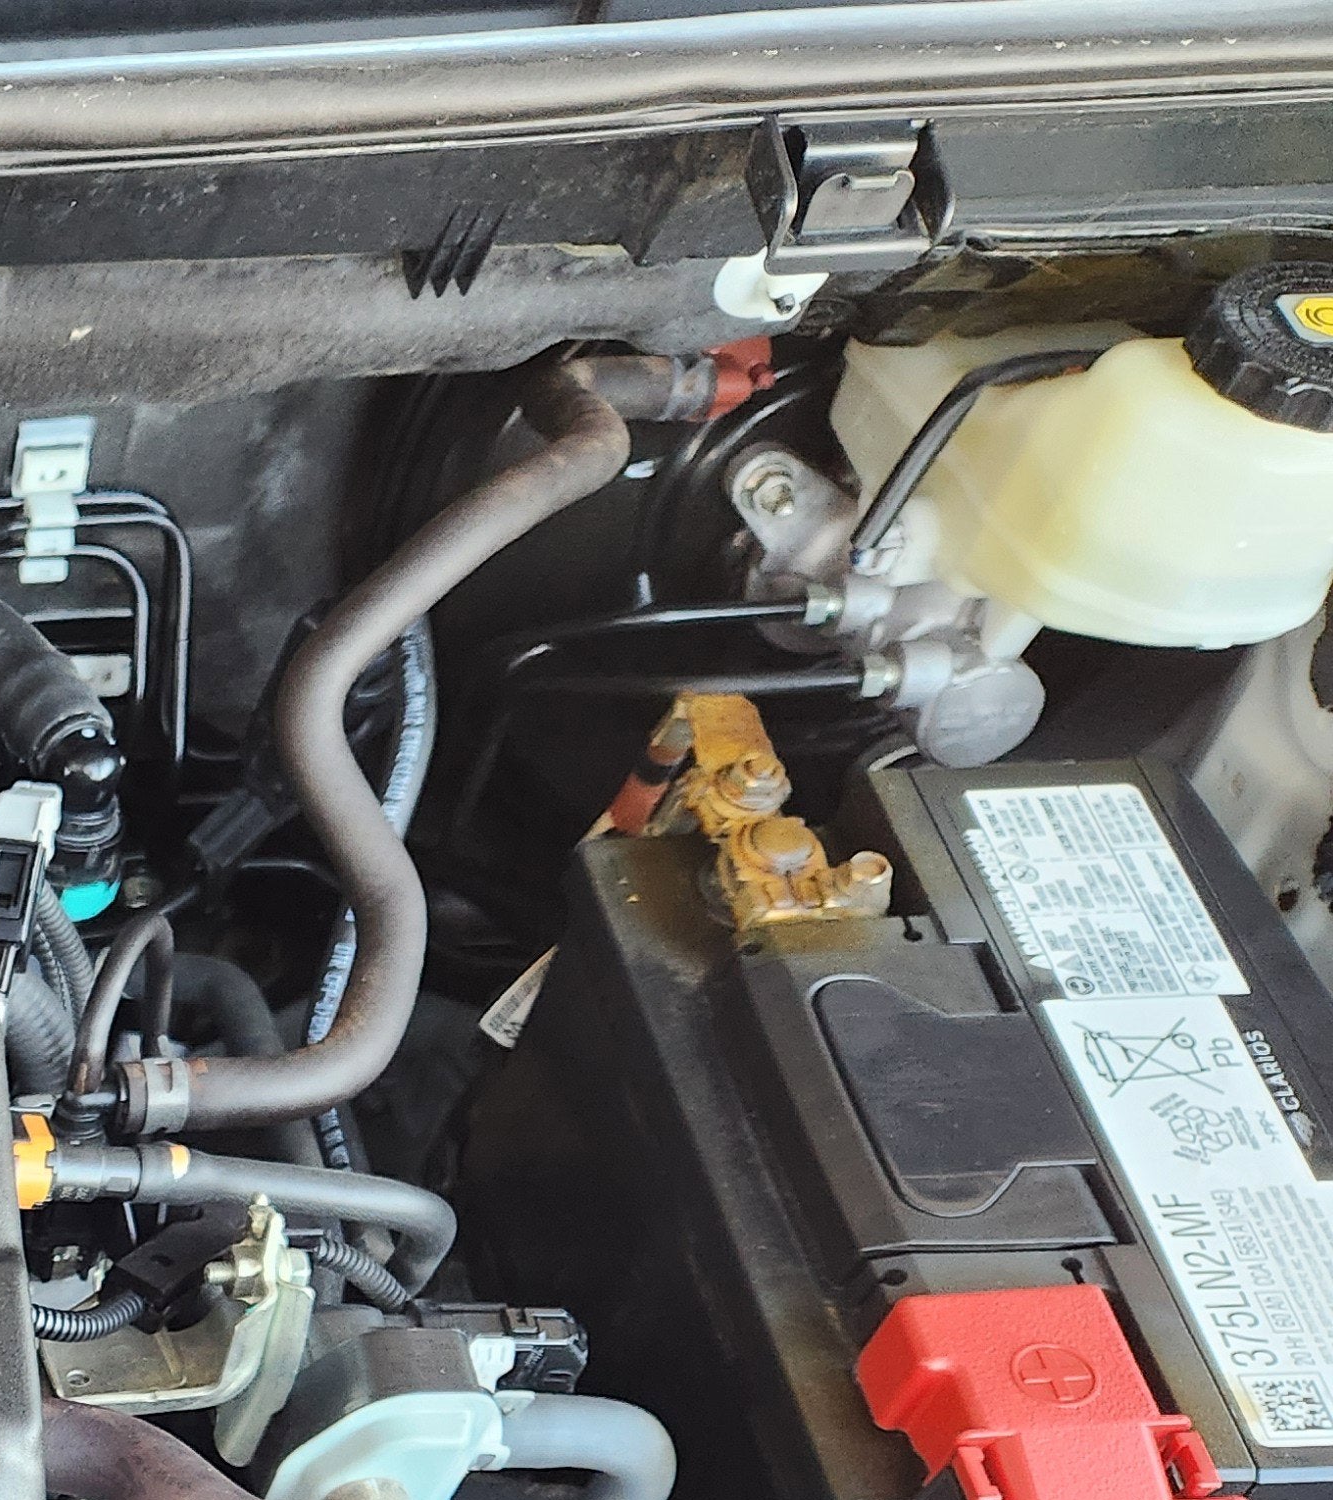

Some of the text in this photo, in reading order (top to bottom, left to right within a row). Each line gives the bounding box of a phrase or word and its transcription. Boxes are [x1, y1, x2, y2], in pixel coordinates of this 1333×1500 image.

[1205, 1036, 1243, 1068] Pb
[1244, 1030, 1302, 1111] CLARIOS
[1154, 1195, 1277, 1367] 375LN2-MF
